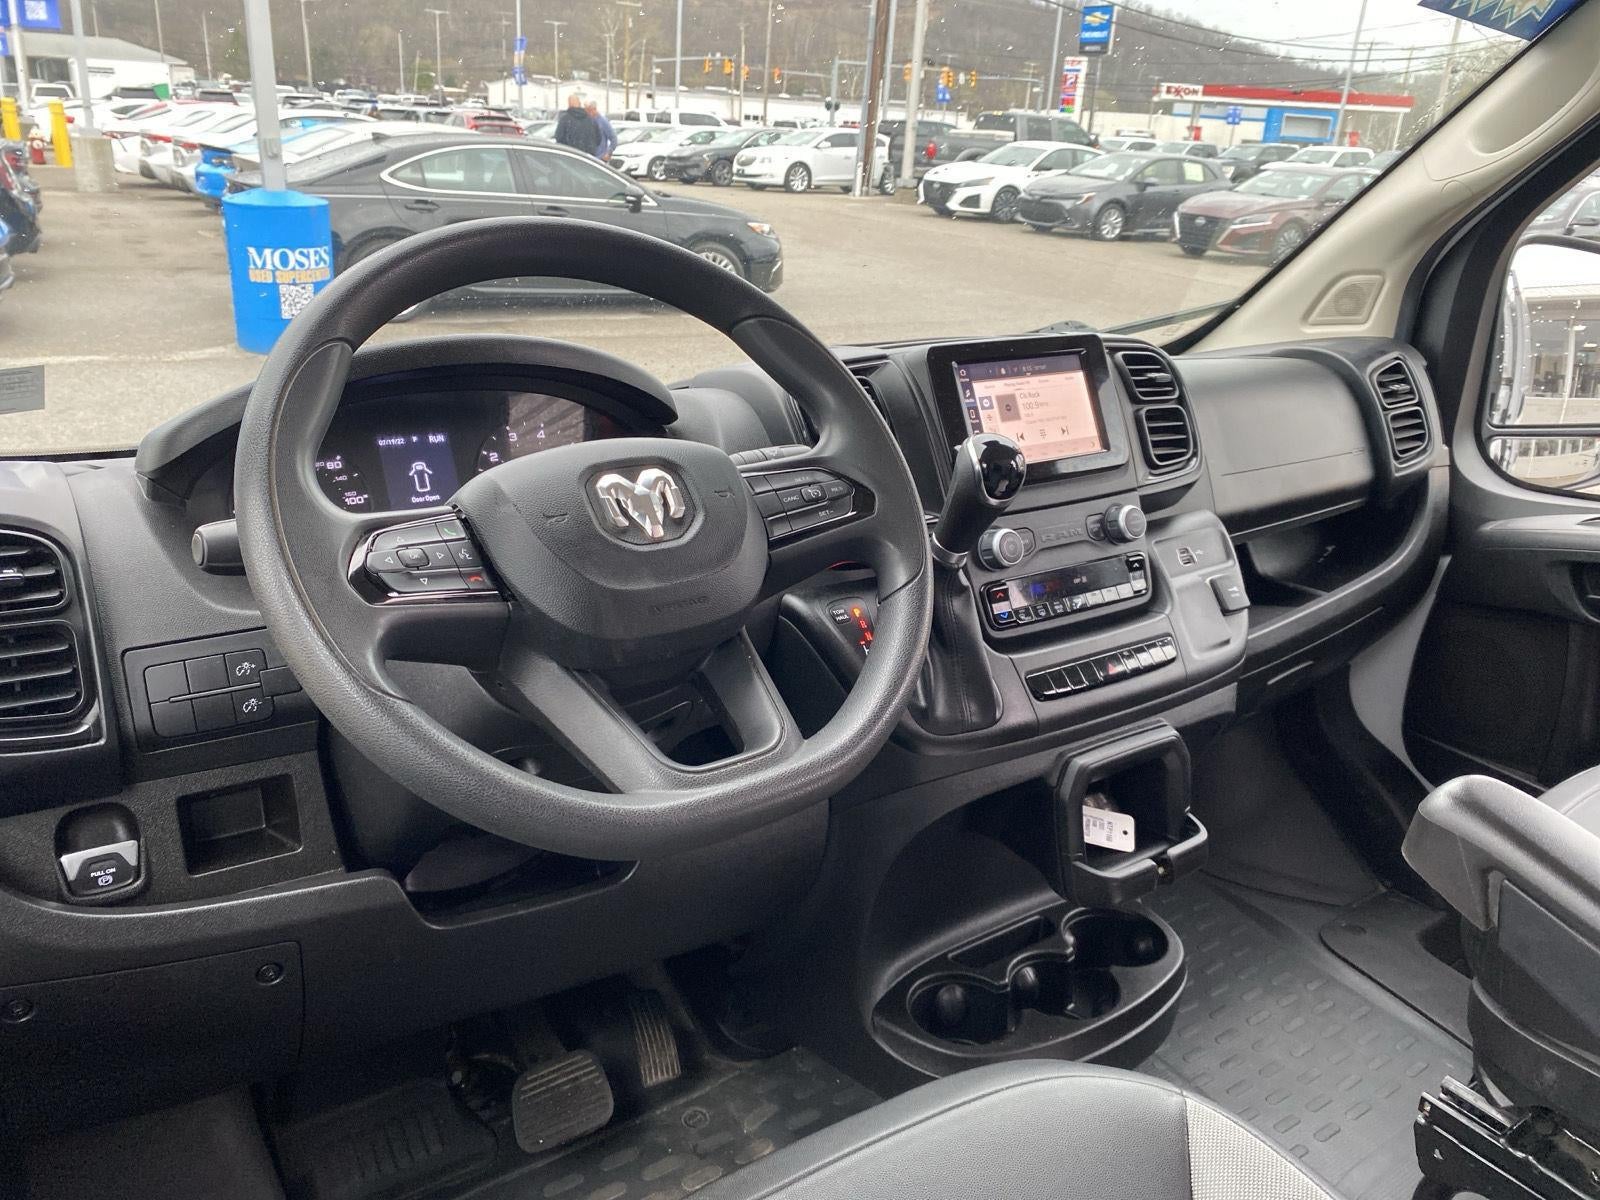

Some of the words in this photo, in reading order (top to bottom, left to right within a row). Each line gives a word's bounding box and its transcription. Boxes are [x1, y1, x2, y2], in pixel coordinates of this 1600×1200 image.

[1165, 85, 1199, 99] EXXON
[246, 246, 330, 271] MOSES
[428, 434, 445, 444] RUN
[508, 432, 518, 442] 3
[536, 430, 546, 439] 4
[489, 452, 499, 462] 2
[326, 461, 343, 470] 80
[344, 496, 365, 506] 100
[853, 608, 861, 618] P
